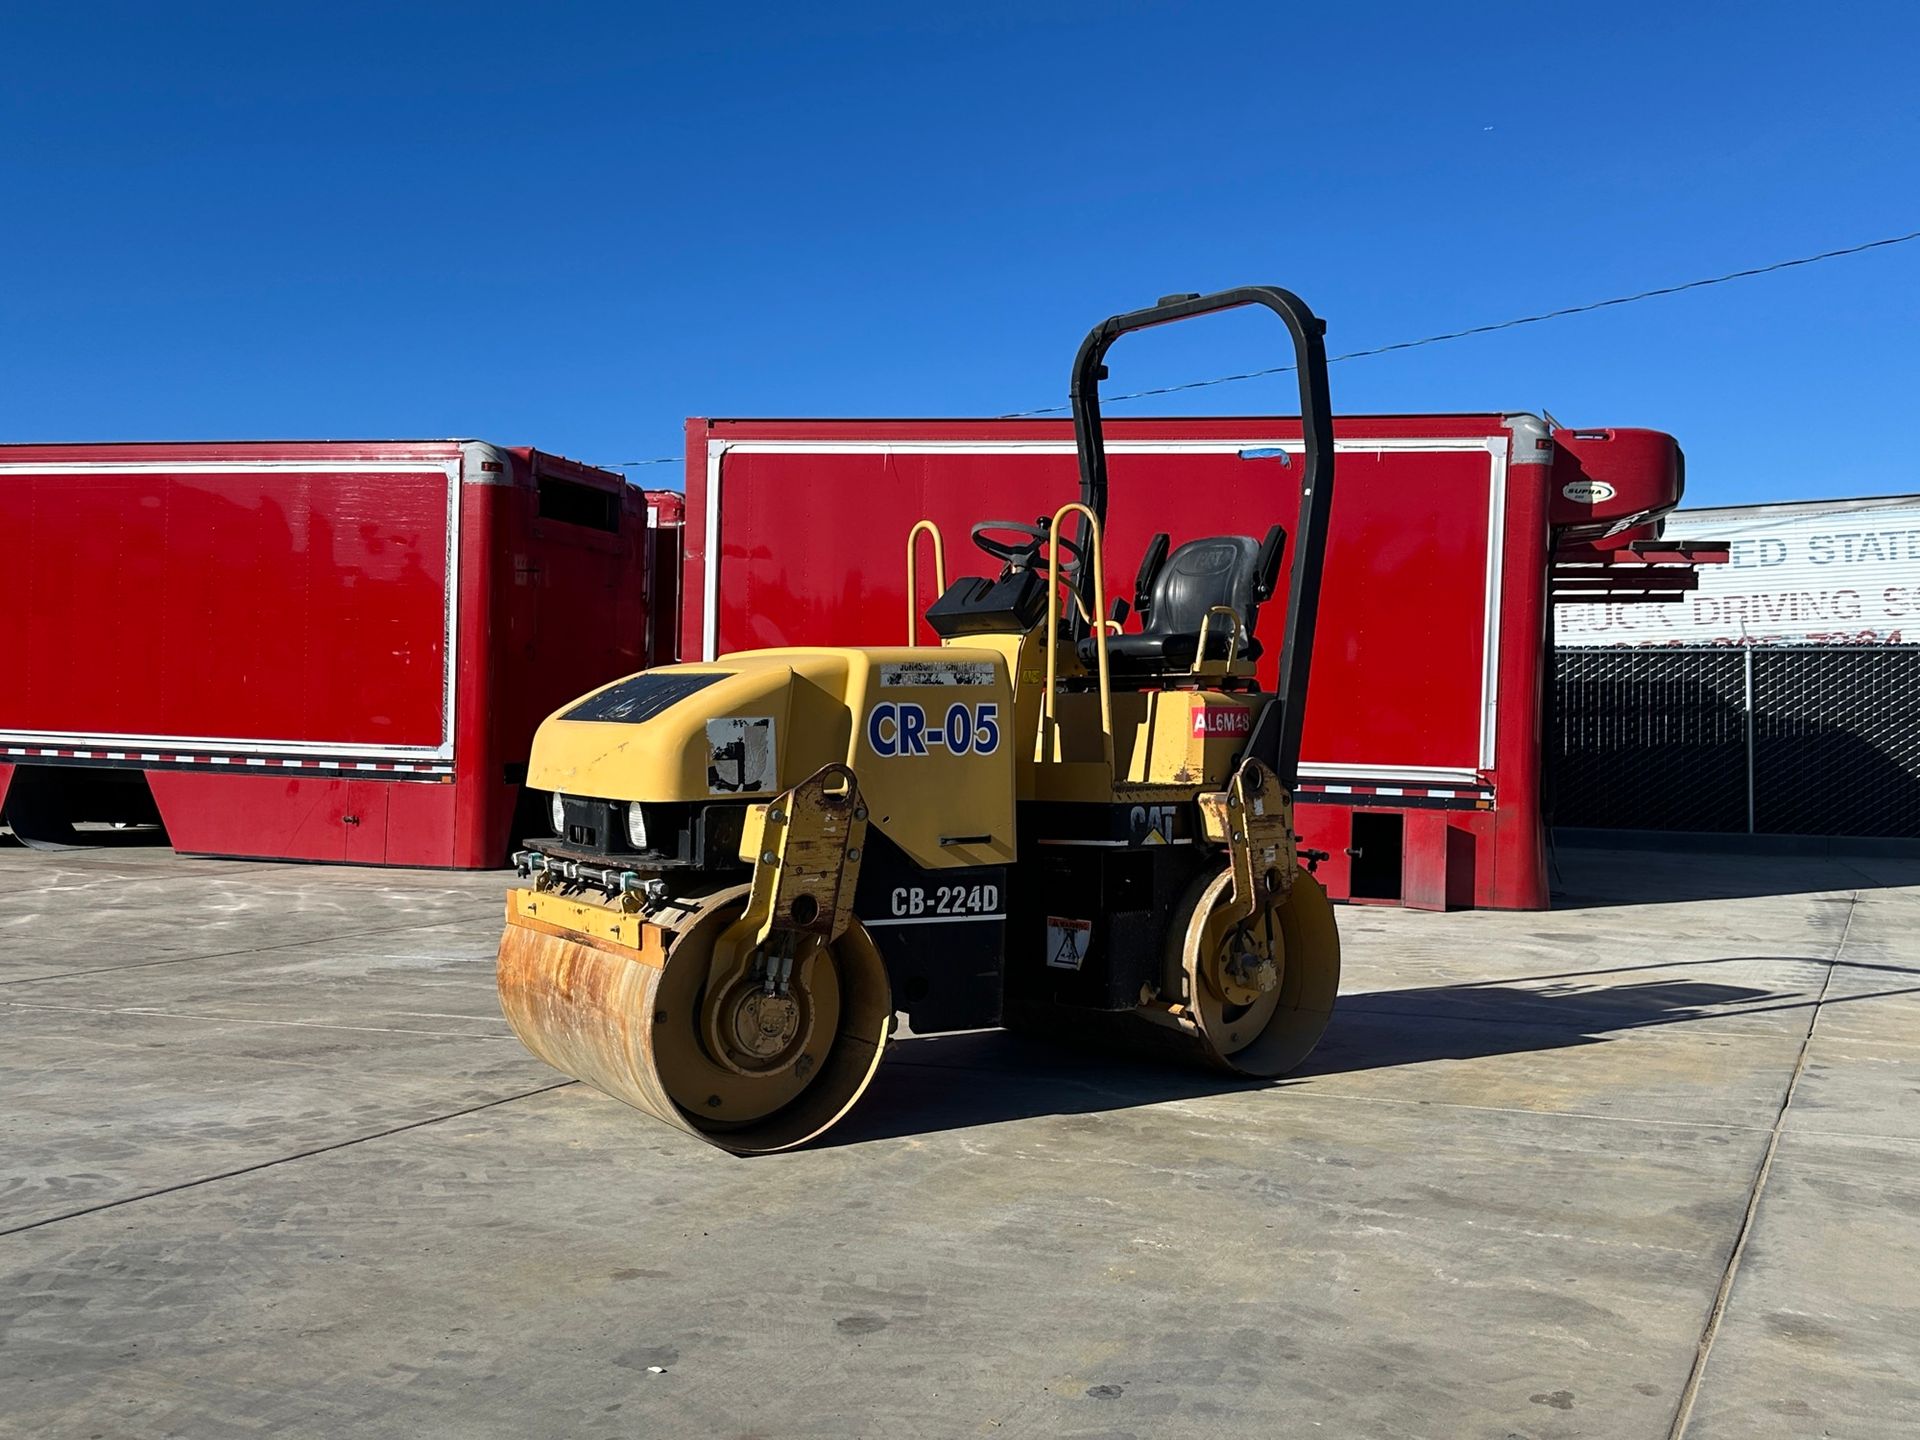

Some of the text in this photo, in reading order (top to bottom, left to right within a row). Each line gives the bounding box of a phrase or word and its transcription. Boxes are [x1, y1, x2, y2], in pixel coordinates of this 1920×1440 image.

[1556, 602, 1674, 632] RUCK
[1694, 590, 1862, 625] DRIVING
[867, 701, 1000, 758] CR-05
[1193, 712, 1250, 732] AL6M48
[1130, 805, 1177, 845] CAT
[891, 884, 998, 916] CB-224D
